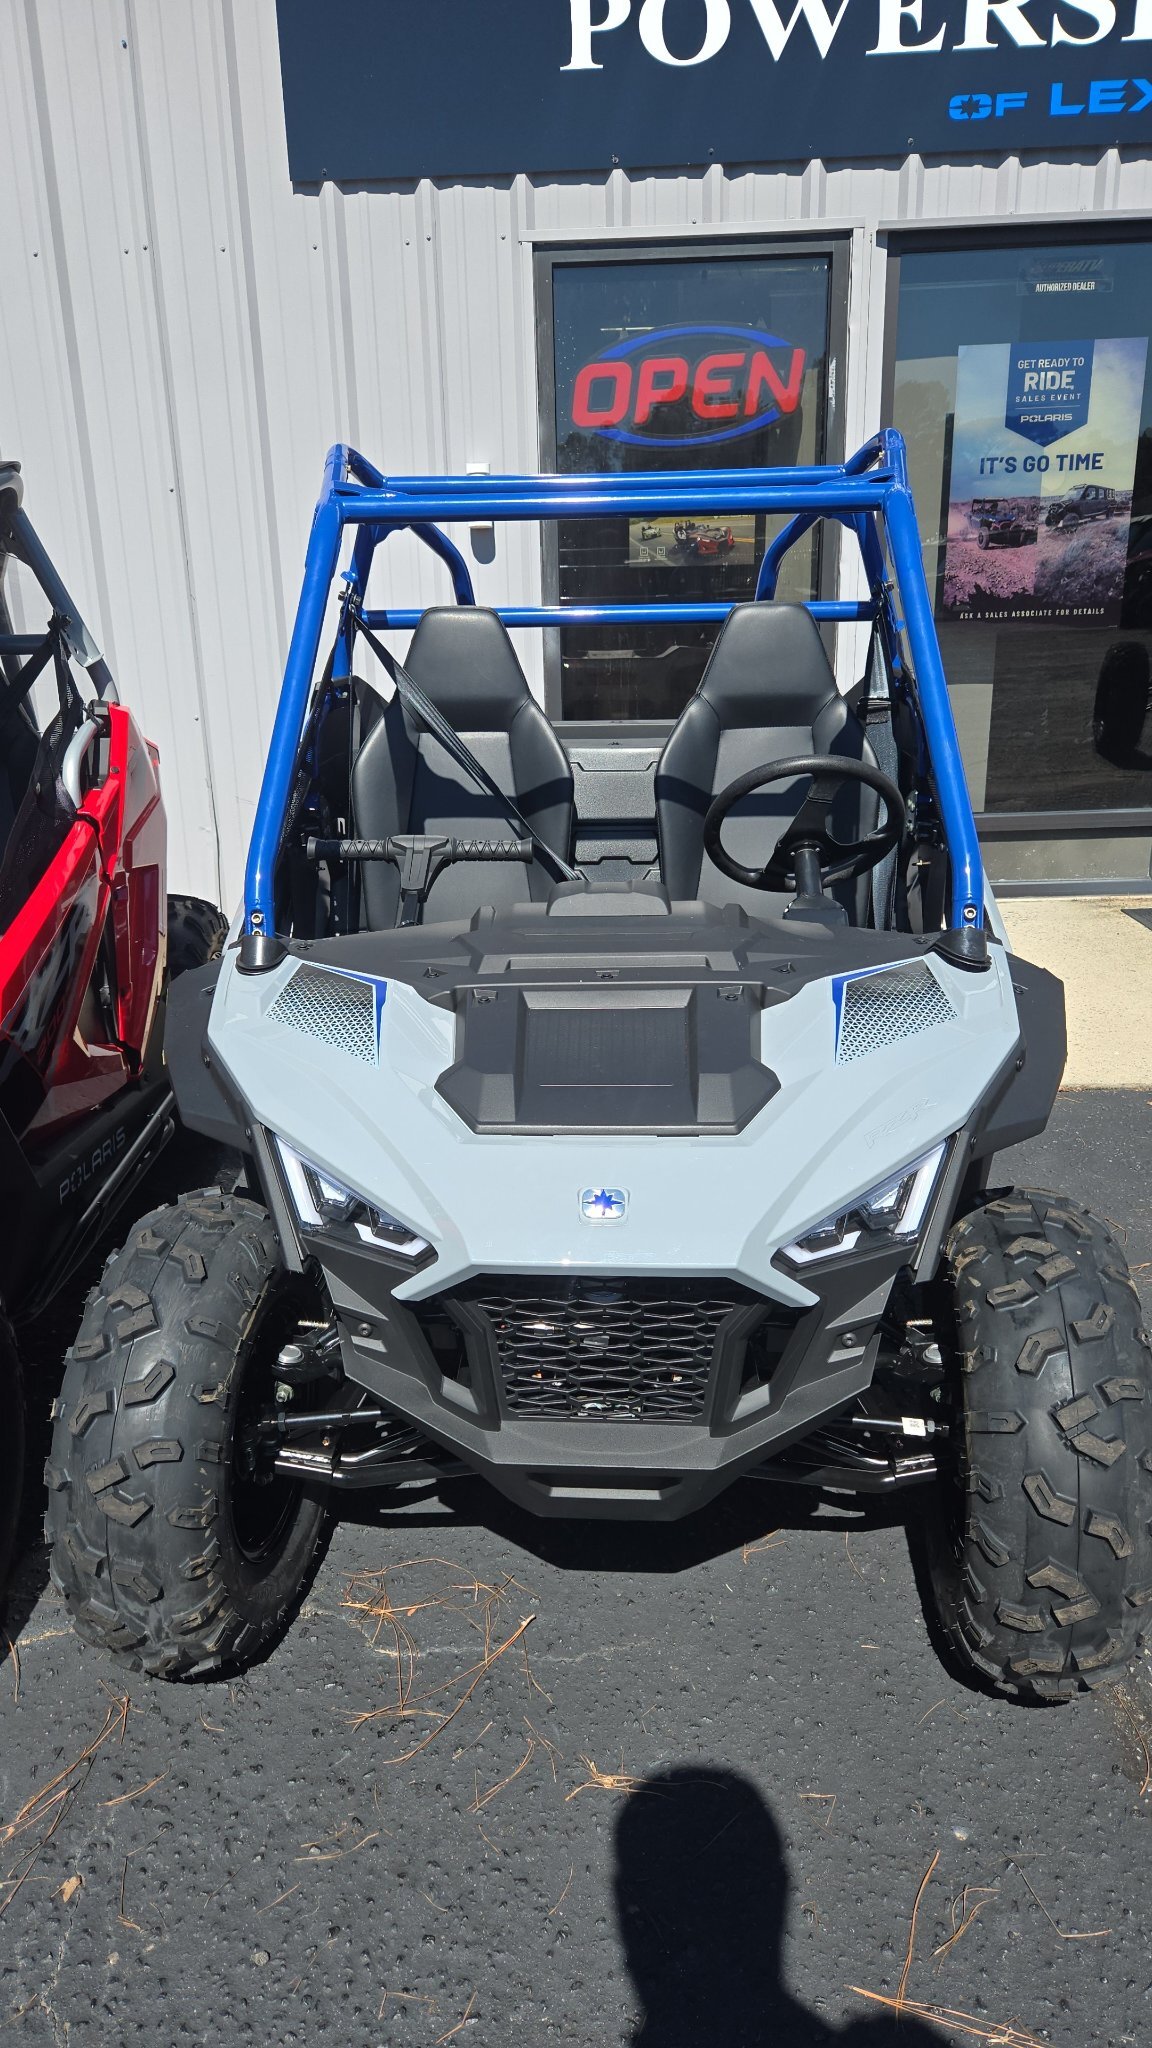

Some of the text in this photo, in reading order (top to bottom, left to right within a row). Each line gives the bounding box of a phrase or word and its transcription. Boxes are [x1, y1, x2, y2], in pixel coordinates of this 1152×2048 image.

[948, 91, 1029, 121] OF
[1035, 281, 1096, 293] AUTHORIZED DEALER
[1017, 356, 1085, 369] GET READY TO
[571, 348, 806, 428] OPEN
[1023, 370, 1076, 393] RIDE
[1015, 393, 1082, 403] SALES EVENT
[1020, 413, 1073, 423] POLARIS
[979, 452, 1105, 475] IT'S GO TIME
[959, 612, 974, 620] ASK
[985, 611, 1008, 619] SALES
[1011, 609, 1052, 618] ASSOCIATE
[1055, 608, 1070, 616] FOR
[1073, 607, 1105, 616] DETAILS
[59, 1125, 126, 1206] POLARIS
